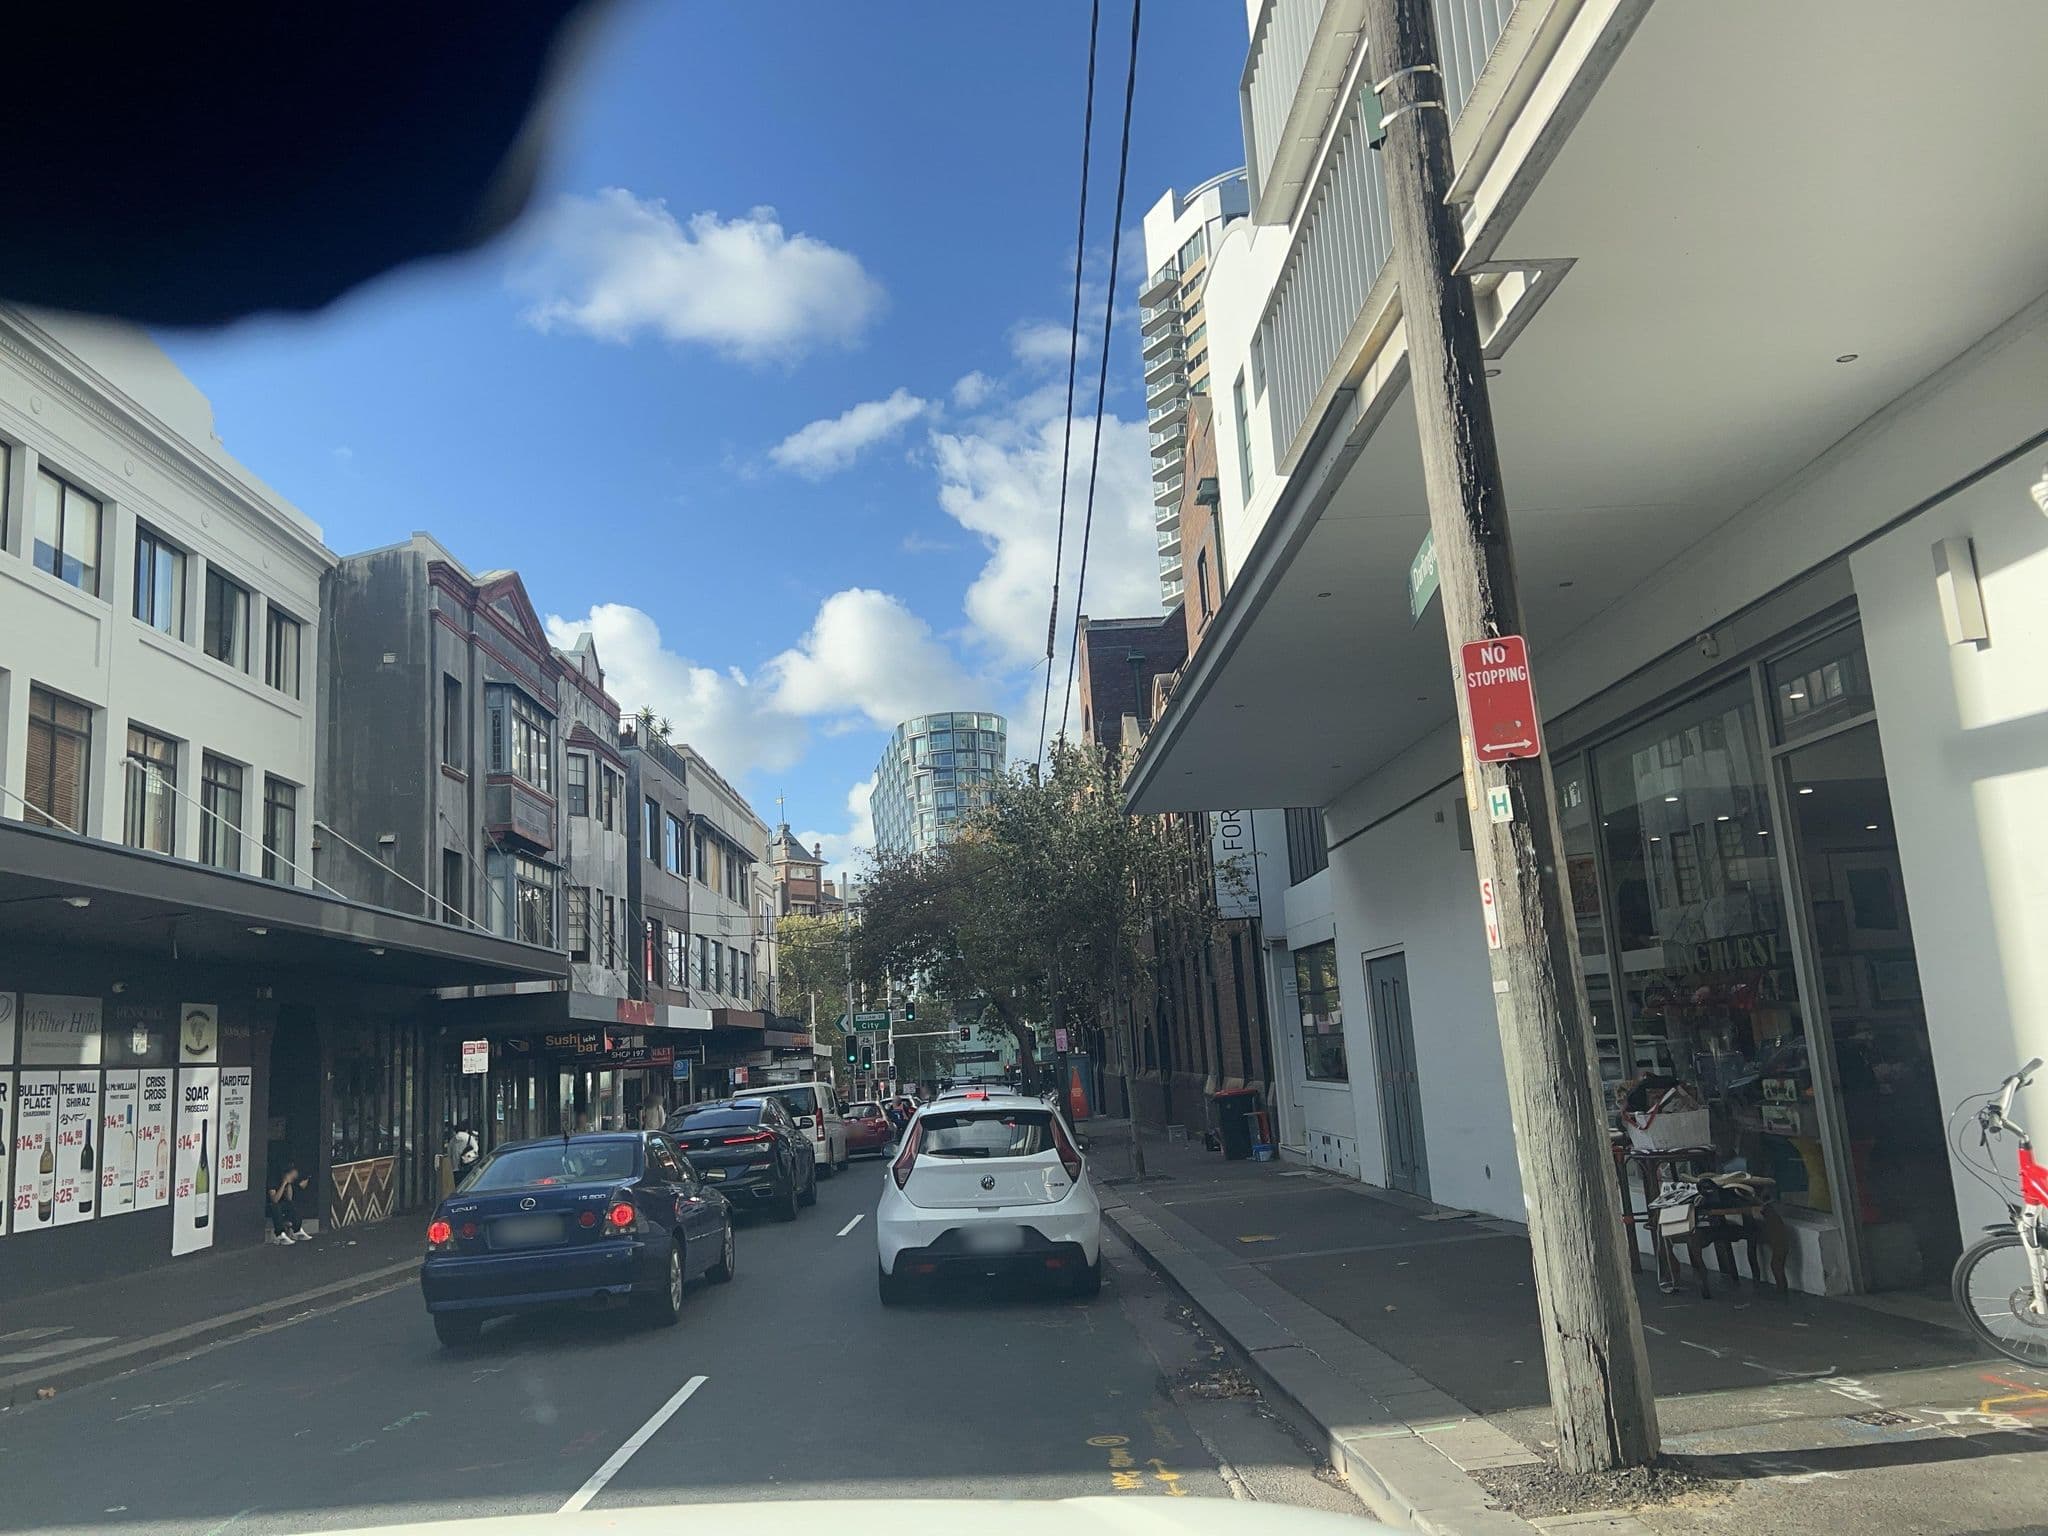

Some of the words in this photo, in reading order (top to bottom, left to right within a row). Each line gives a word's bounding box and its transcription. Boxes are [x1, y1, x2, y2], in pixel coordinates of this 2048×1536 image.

[1480, 646, 1506, 666] NO
[1467, 665, 1527, 688] STOPPING
[1491, 793, 1508, 816] H
[1220, 809, 1243, 850] FOR
[1483, 882, 1492, 904] S
[1489, 924, 1497, 946] V
[861, 1022, 880, 1030] City
[577, 1039, 599, 1053] bar
[632, 1049, 645, 1057] 197
[61, 1083, 75, 1095] THE
[76, 1082, 97, 1094] WALL
[146, 1076, 166, 1088] CRISS
[20, 1084, 58, 1097] BULLETIN
[144, 1088, 167, 1101] CROSS
[185, 1086, 209, 1102] SOAR
[24, 1097, 52, 1110] PLACE
[66, 1097, 91, 1108] SHIRAZ
